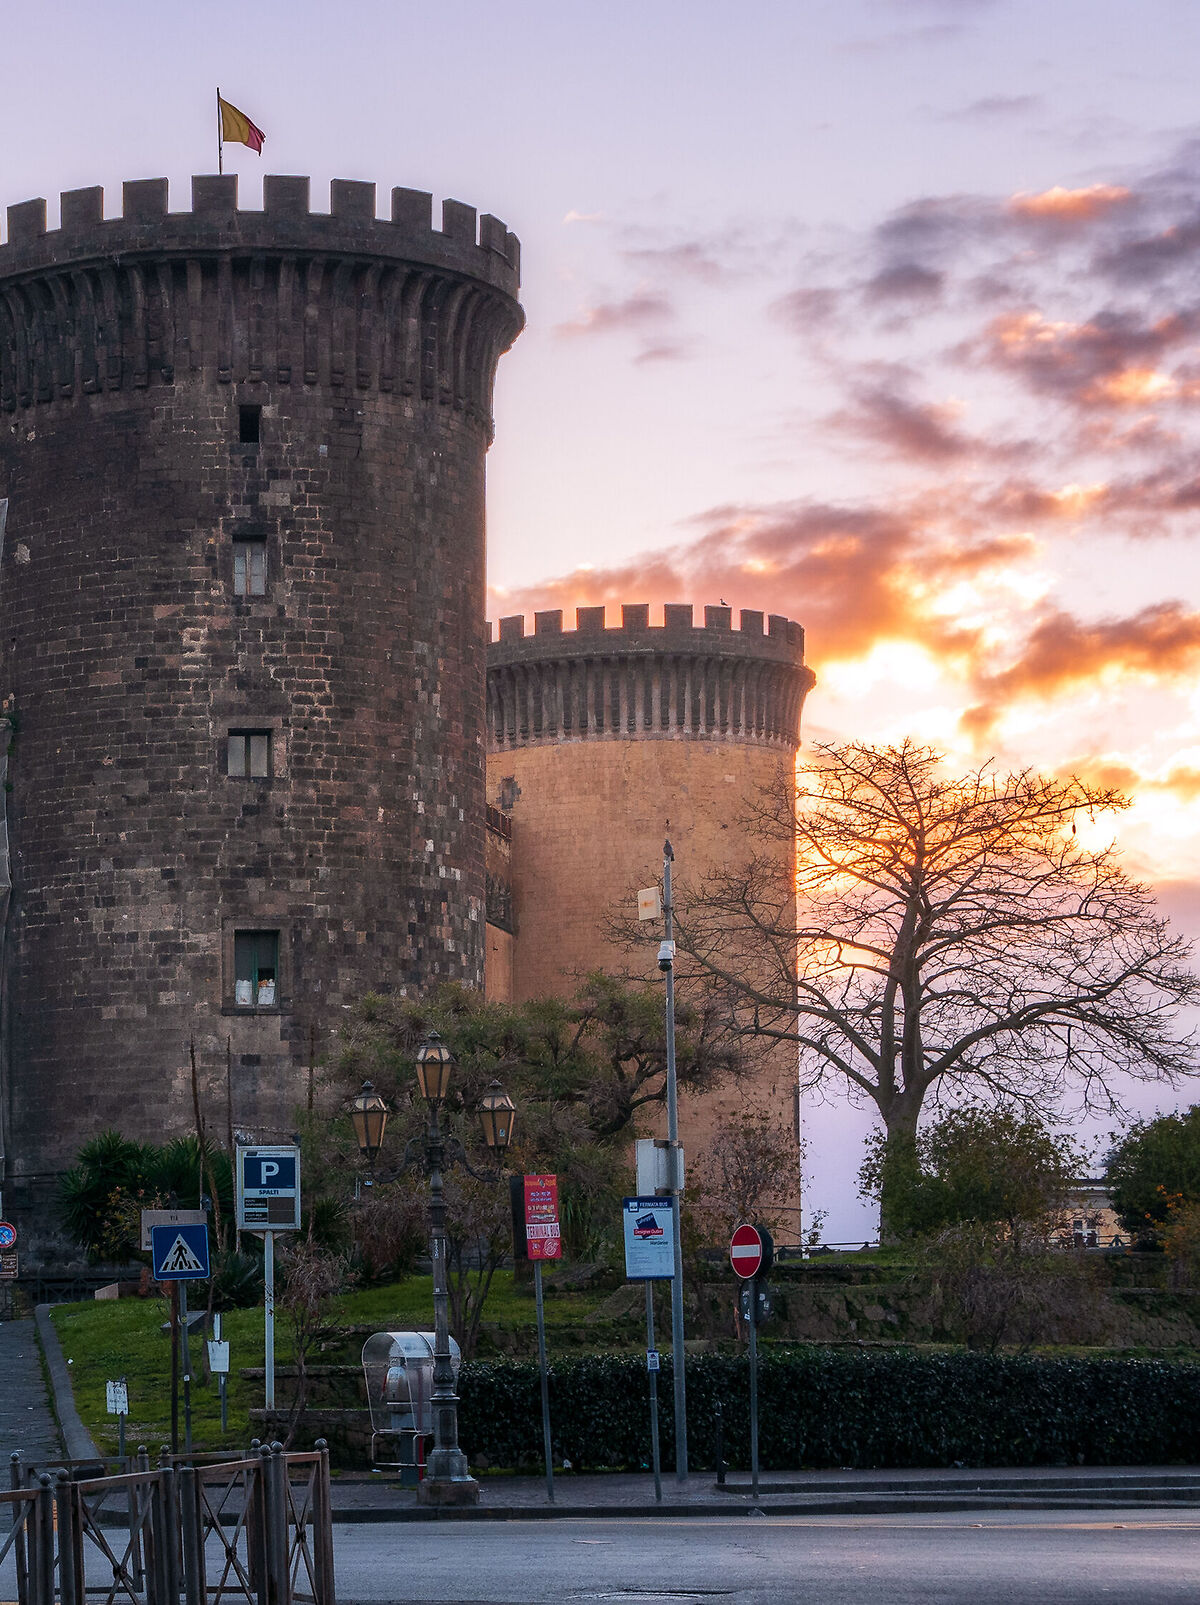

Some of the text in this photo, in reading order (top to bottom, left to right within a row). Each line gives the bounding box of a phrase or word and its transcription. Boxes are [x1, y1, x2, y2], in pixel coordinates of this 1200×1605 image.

[261, 1161, 280, 1185] P
[527, 1224, 560, 1238] TERMINAL BUS
